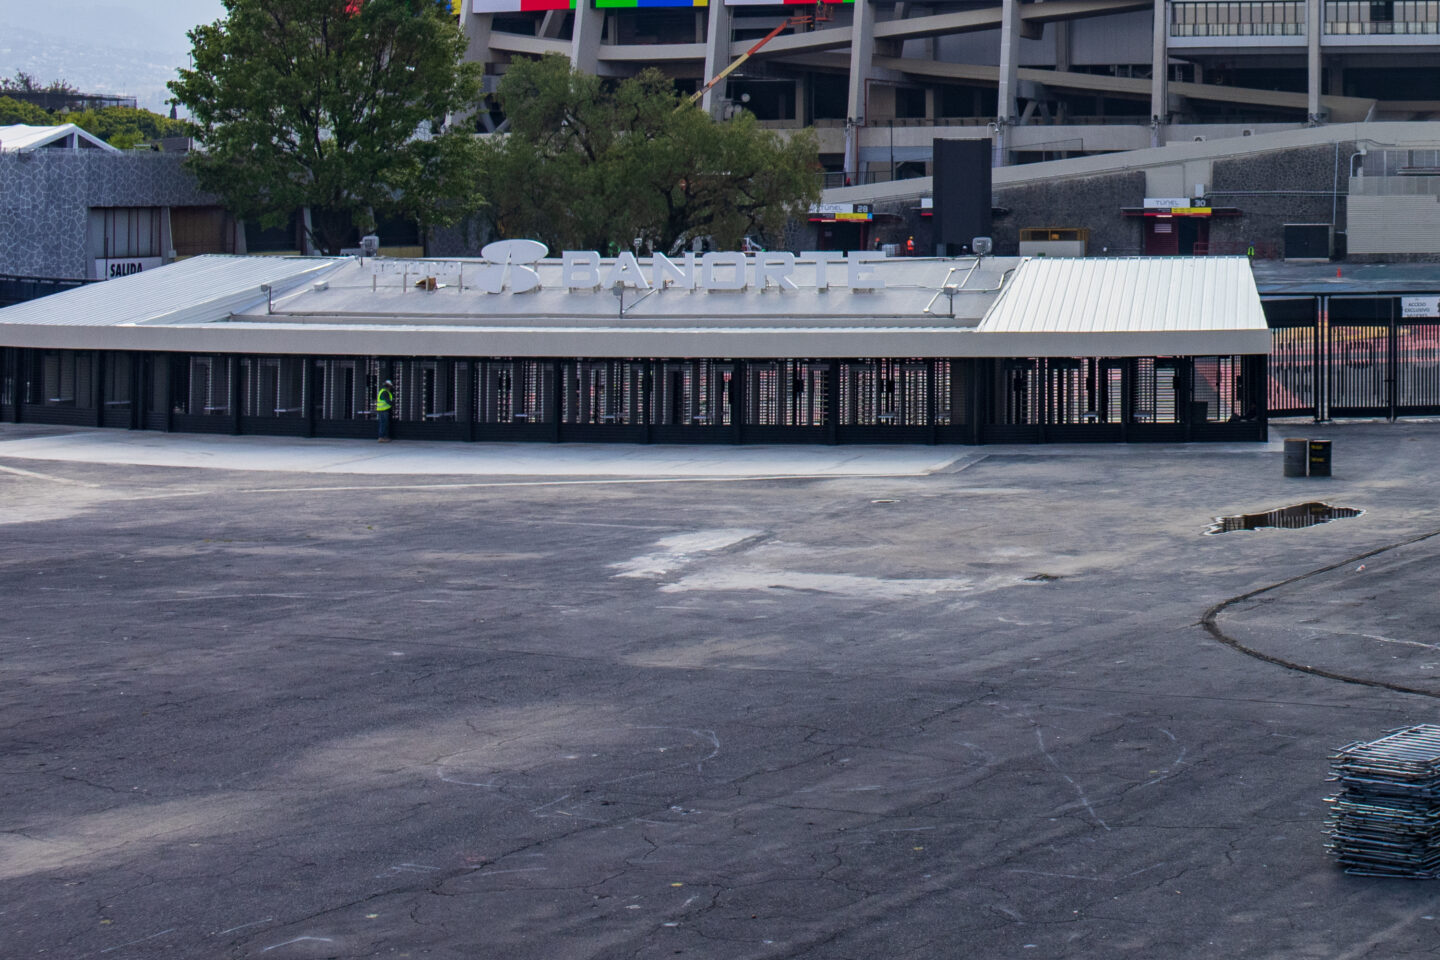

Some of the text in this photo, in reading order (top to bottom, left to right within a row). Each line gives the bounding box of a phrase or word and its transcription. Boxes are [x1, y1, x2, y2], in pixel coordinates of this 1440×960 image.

[1195, 199, 1207, 207] 30
[110, 262, 143, 277] SALIDA
[562, 251, 886, 289] BANORTE
